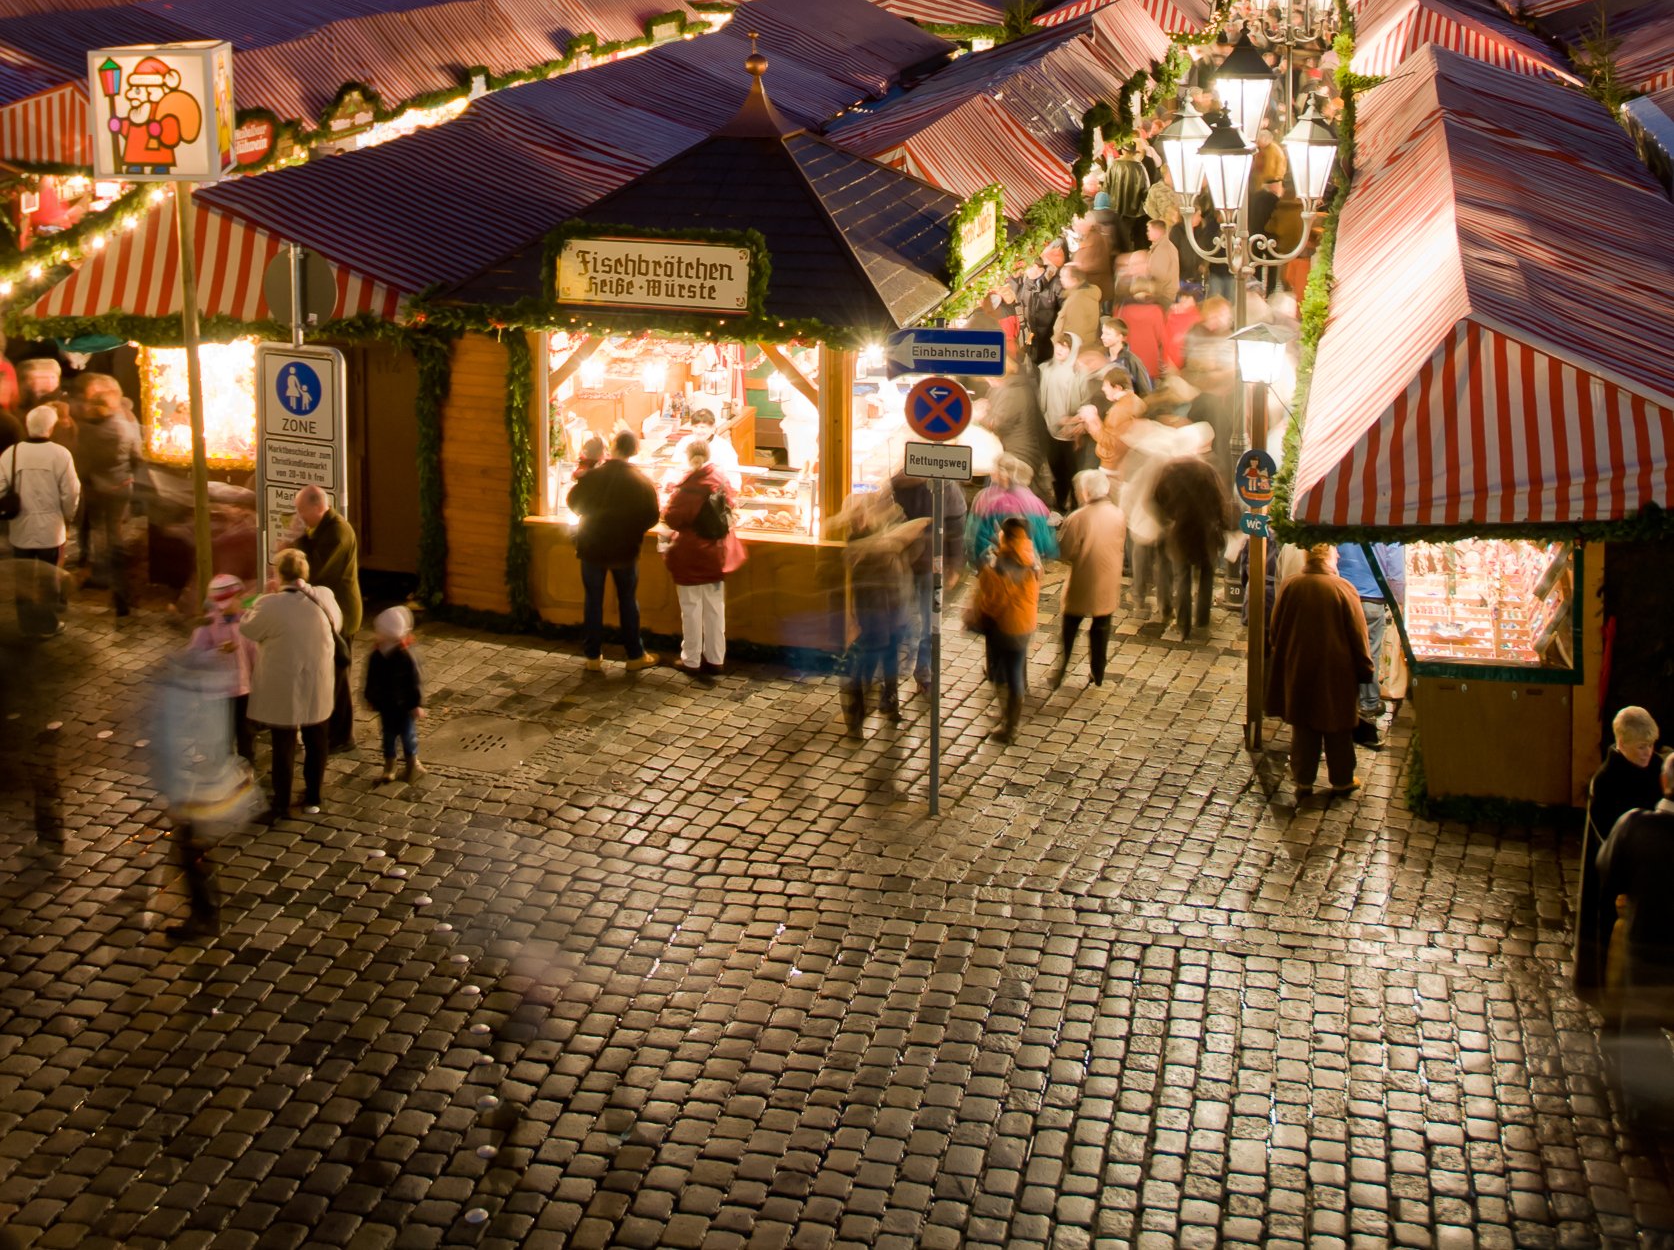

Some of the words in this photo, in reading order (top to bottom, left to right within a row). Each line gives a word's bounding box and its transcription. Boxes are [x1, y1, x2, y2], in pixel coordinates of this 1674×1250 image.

[575, 249, 734, 282] Fischbrötchen
[584, 276, 635, 297] Heiße
[645, 278, 717, 301] Würste
[911, 345, 997, 359] Einbahnstraße
[281, 418, 317, 435] ZONE
[909, 454, 967, 471] Rettungsweg
[1246, 519, 1262, 530] WC
[1230, 587, 1240, 595] 20
